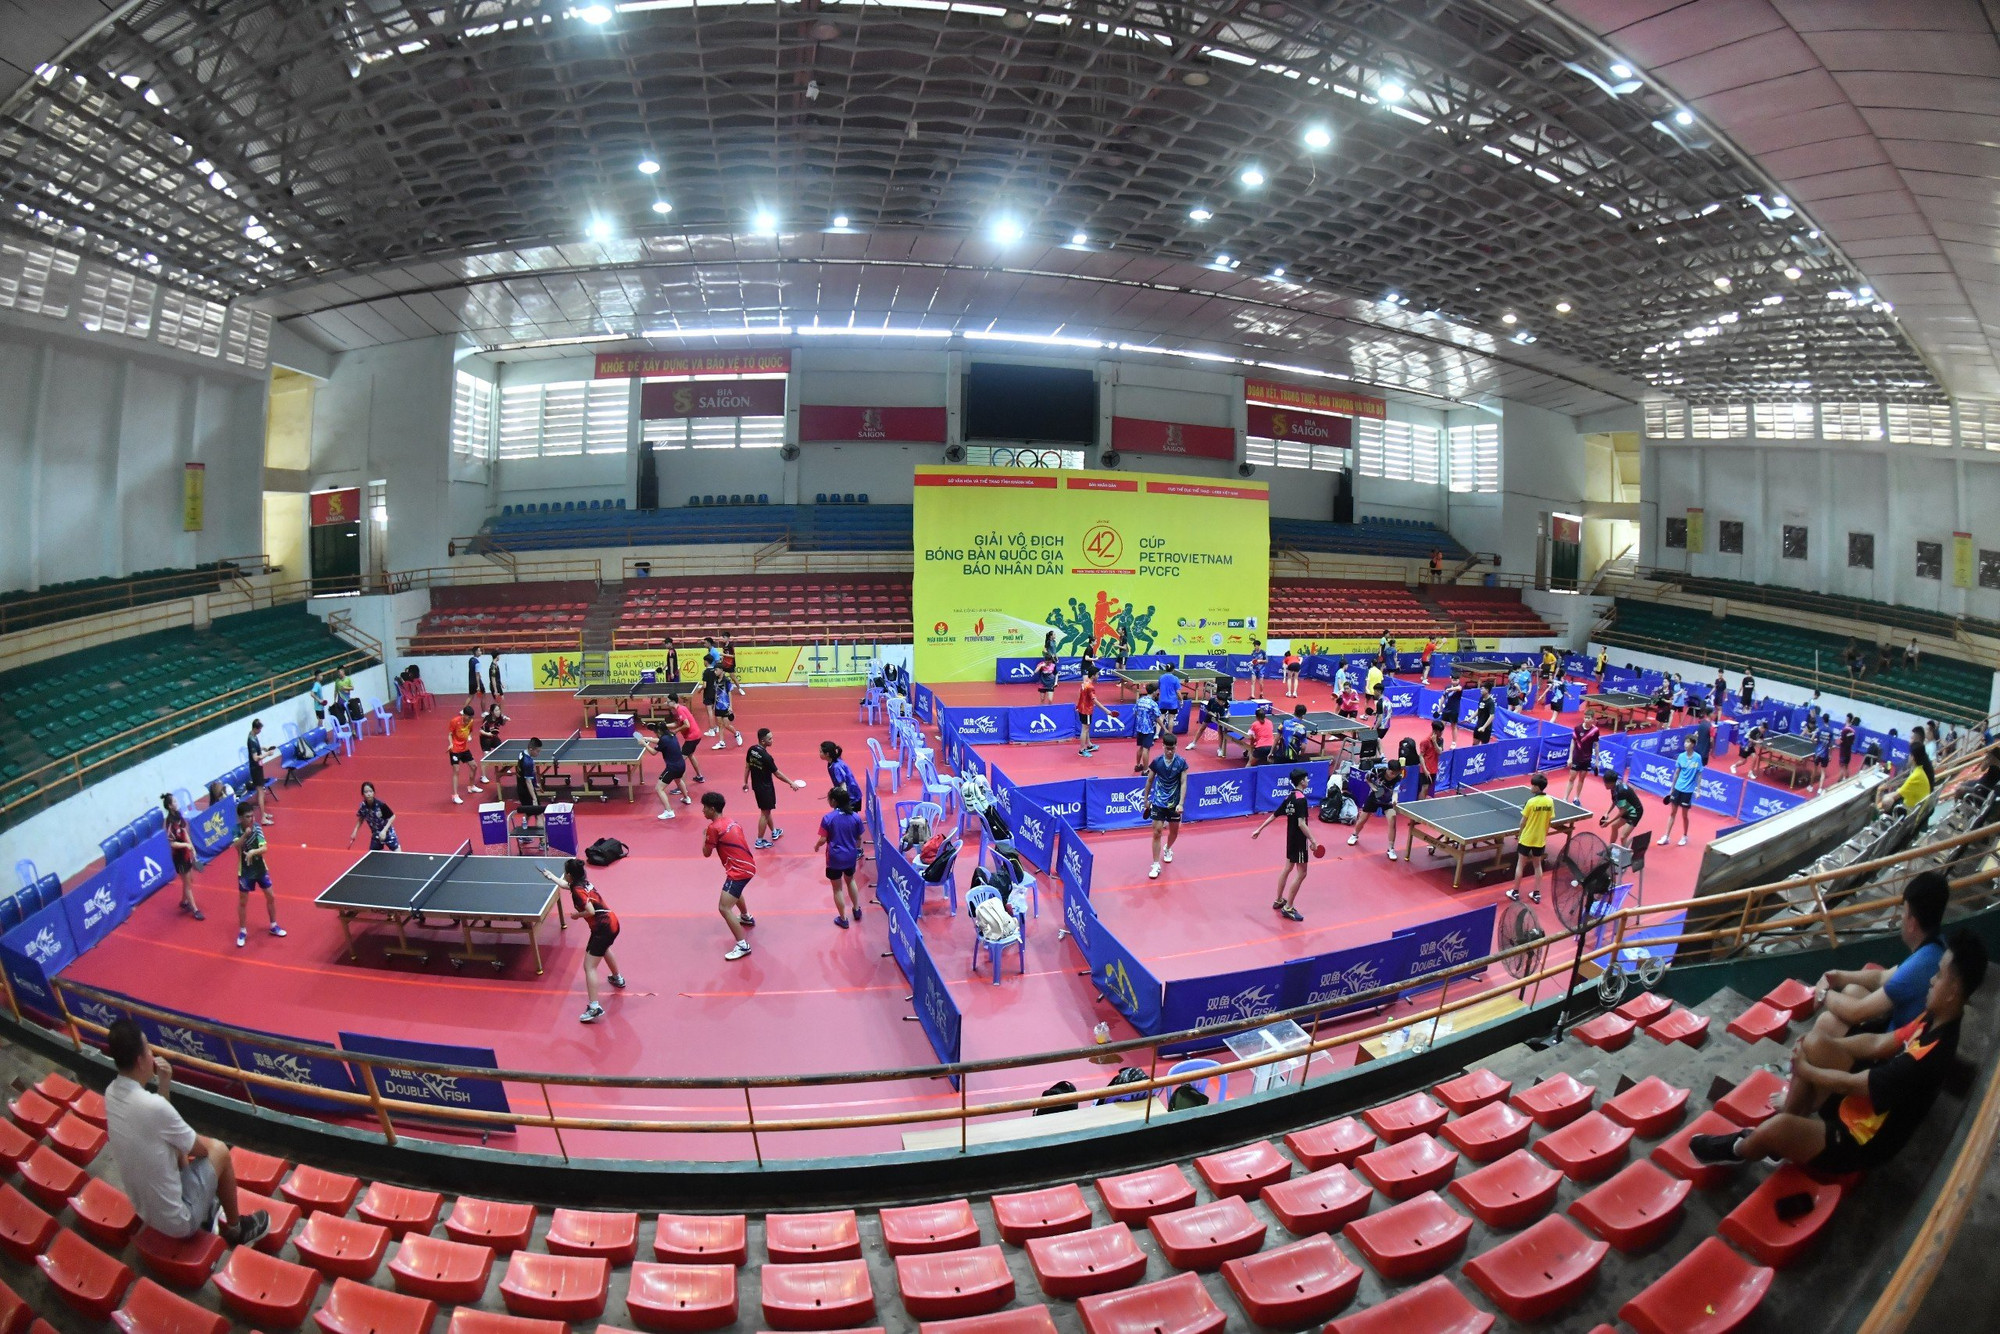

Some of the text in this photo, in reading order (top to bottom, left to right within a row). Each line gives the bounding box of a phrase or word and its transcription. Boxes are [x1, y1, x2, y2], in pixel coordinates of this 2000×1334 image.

[600, 356, 624, 373] KHỎE
[642, 356, 659, 372] XÂY
[728, 355, 740, 372] VỆ
[758, 354, 783, 370] QUỐC
[717, 388, 733, 396] BIA
[699, 396, 750, 408] SAIGON
[1292, 424, 1328, 438] SAIGON
[974, 531, 1064, 548] GIẢI VÔ ĐỊCH
[1087, 531, 1114, 557] 42
[1139, 535, 1166, 548] CÚP
[926, 544, 1064, 560] BÓNG BÀN QUỐC GIA
[1139, 552, 1232, 565] PETROVIETNAM
[963, 561, 1064, 574] BÁO NHÂN DÂN
[1139, 566, 1180, 576] PVCFC
[616, 660, 664, 669] GIẢI VÔ ĐỊCH
[683, 661, 695, 674] 42
[1199, 794, 1242, 807] DOUBLE FISH
[1106, 805, 1132, 814] DOUBLE
[1019, 826, 1034, 842] DOUBLE
[1411, 948, 1469, 974] DOUBLE FISH
[1320, 971, 1340, 987] 双鱼
[1307, 980, 1381, 1003] DOUBLE FISH
[1206, 995, 1230, 1011] 双鱼
[1195, 1006, 1277, 1029] DOUBLE FISH
[385, 1080, 471, 1103] DOUBLE FISH
